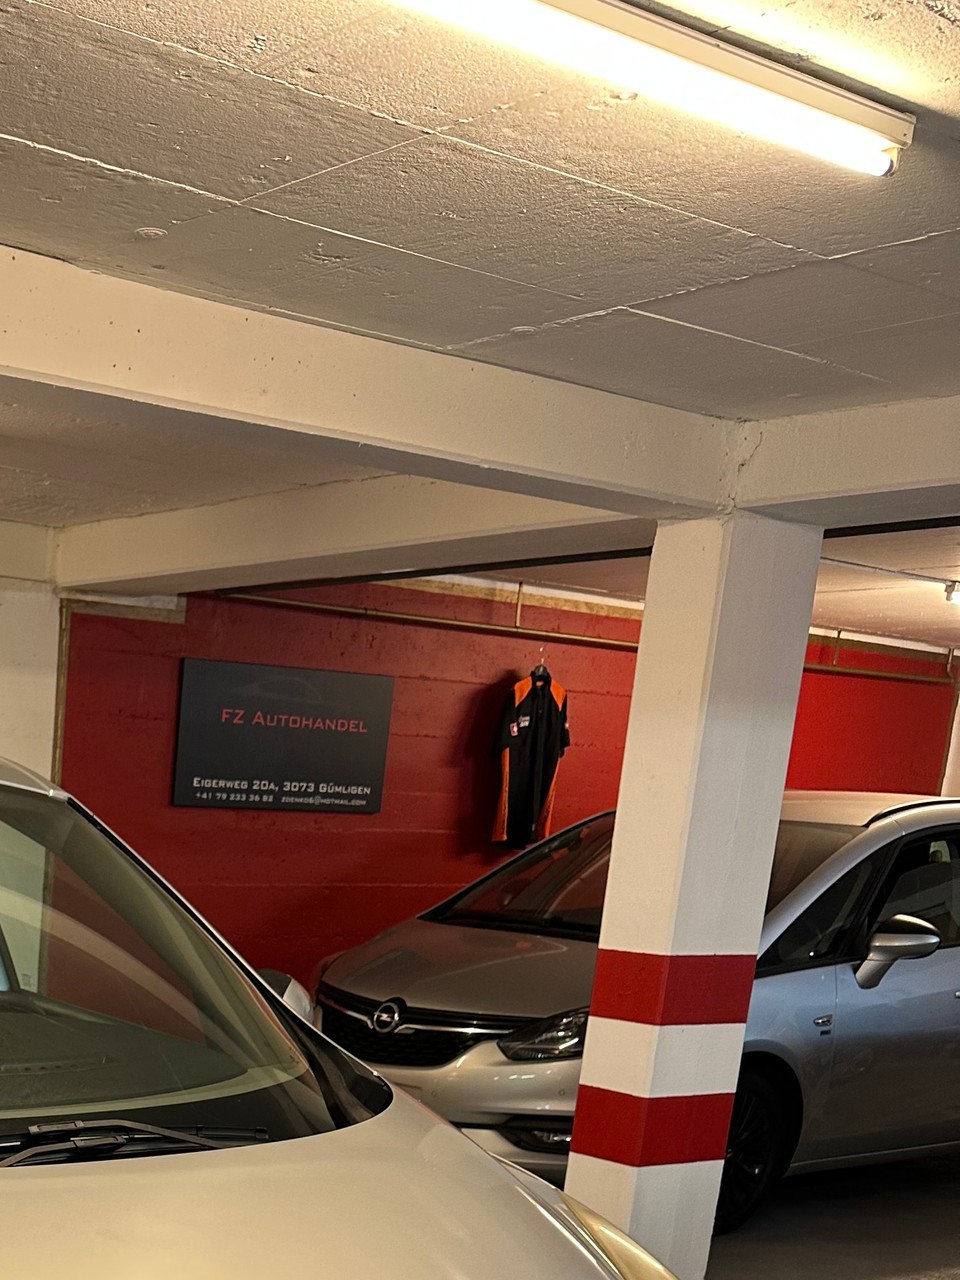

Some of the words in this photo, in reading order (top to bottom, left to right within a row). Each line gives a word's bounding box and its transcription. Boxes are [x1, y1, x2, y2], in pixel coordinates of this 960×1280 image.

[221, 708, 245, 725] FZ
[252, 711, 368, 733] AUTOHANDEL
[282, 781, 315, 792] 3073
[196, 792, 212, 800] +41
[215, 792, 227, 801] 79
